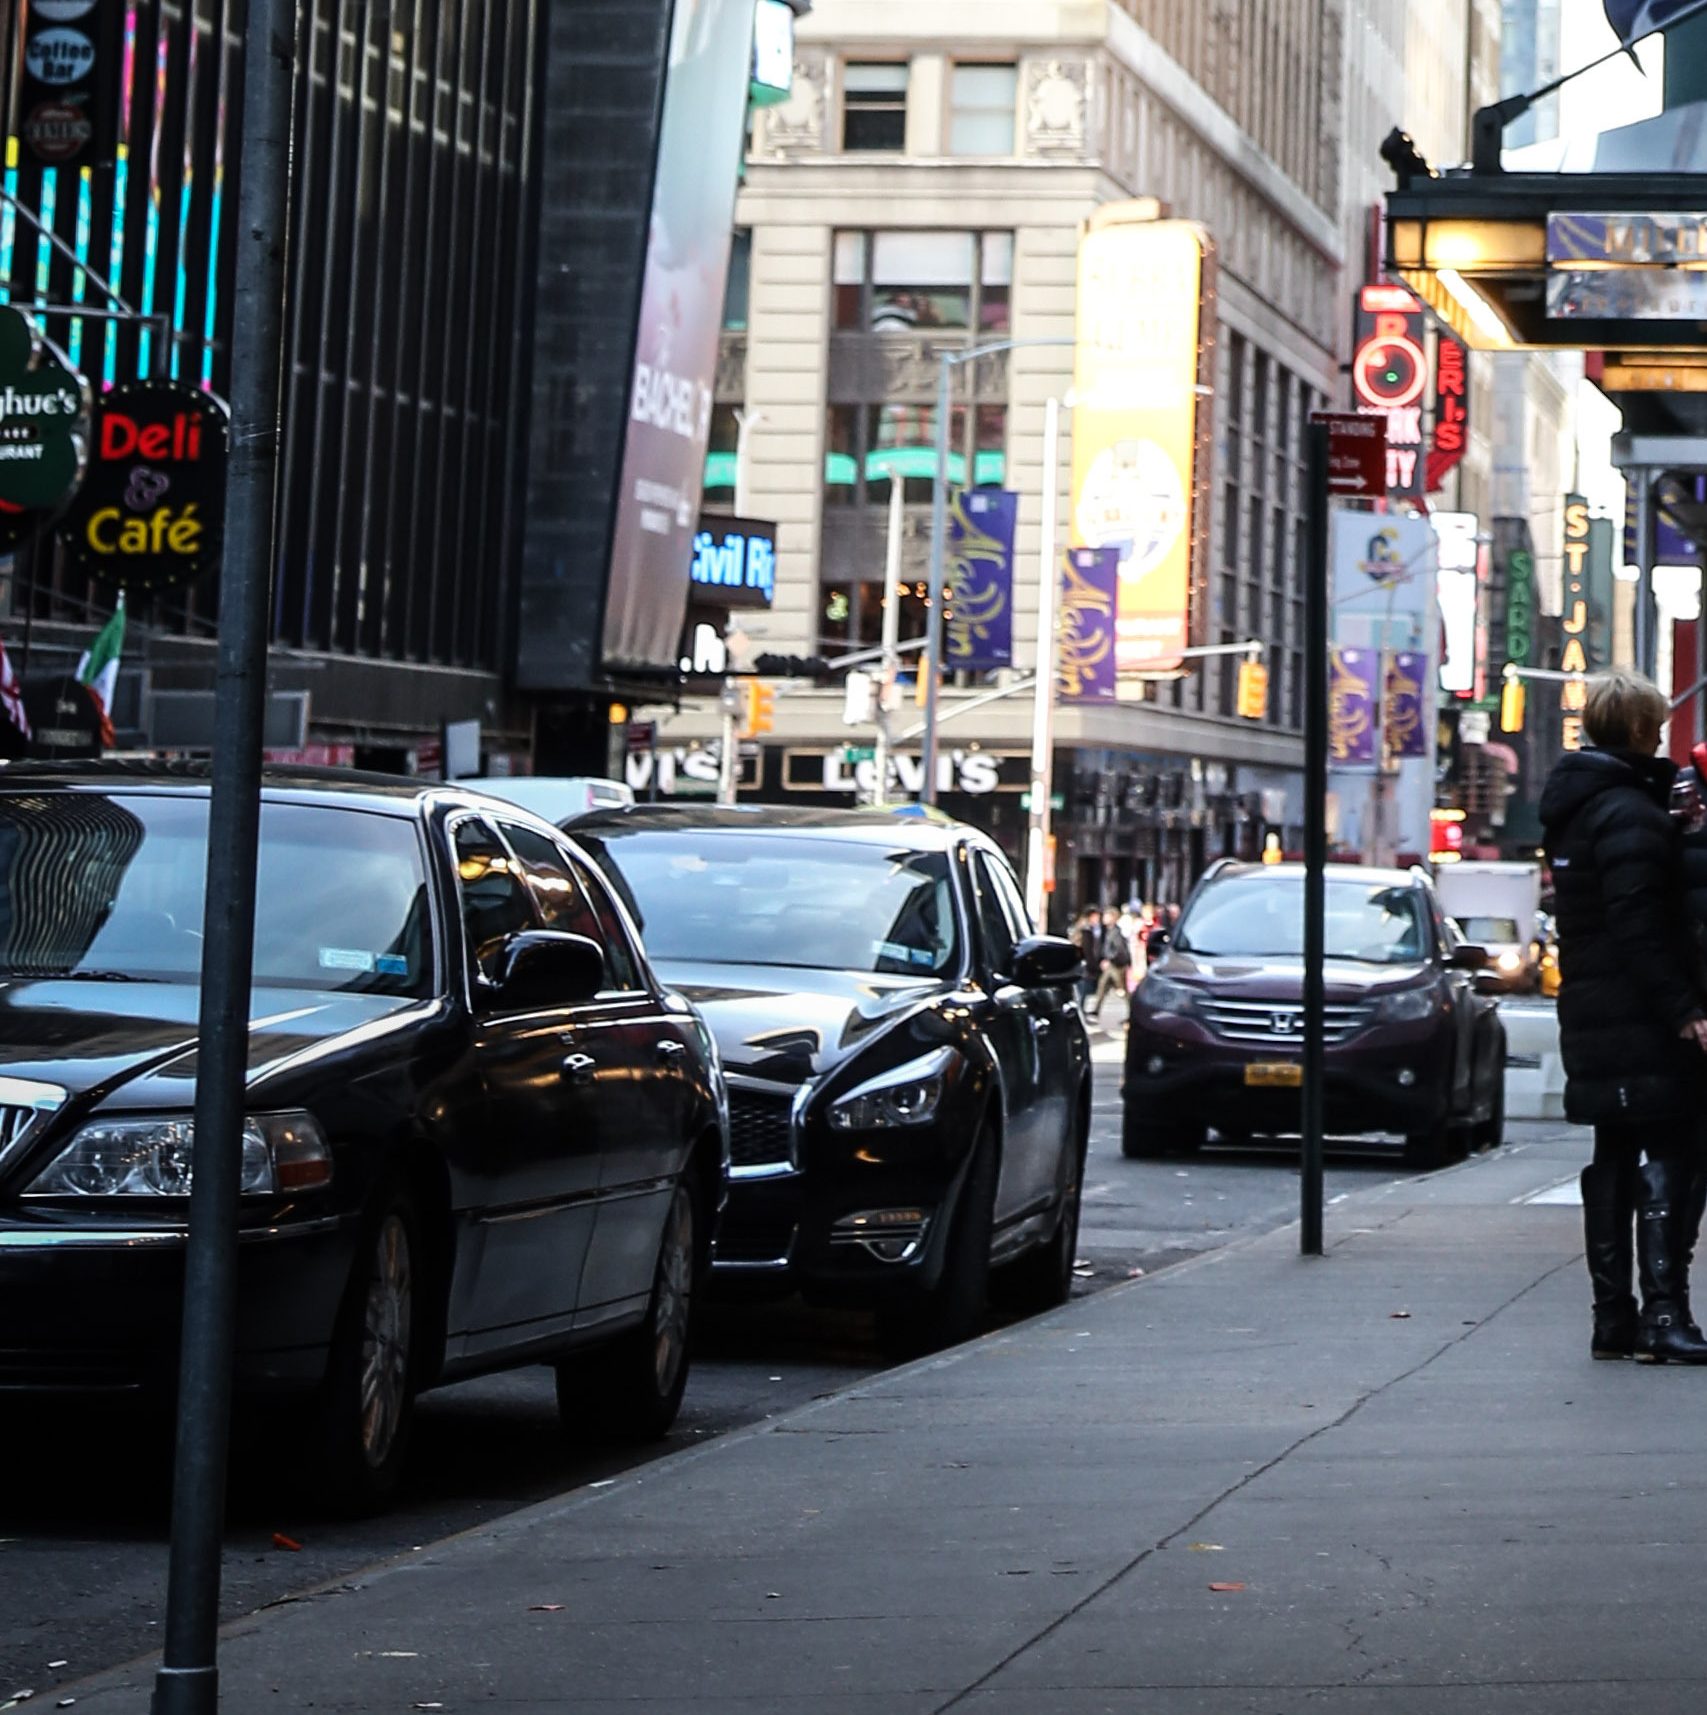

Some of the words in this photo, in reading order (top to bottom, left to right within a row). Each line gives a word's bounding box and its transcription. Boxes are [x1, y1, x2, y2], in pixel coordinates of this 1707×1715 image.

[1436, 339, 1466, 451] ERI'S
[100, 413, 202, 460] Deli
[87, 502, 203, 554] Café
